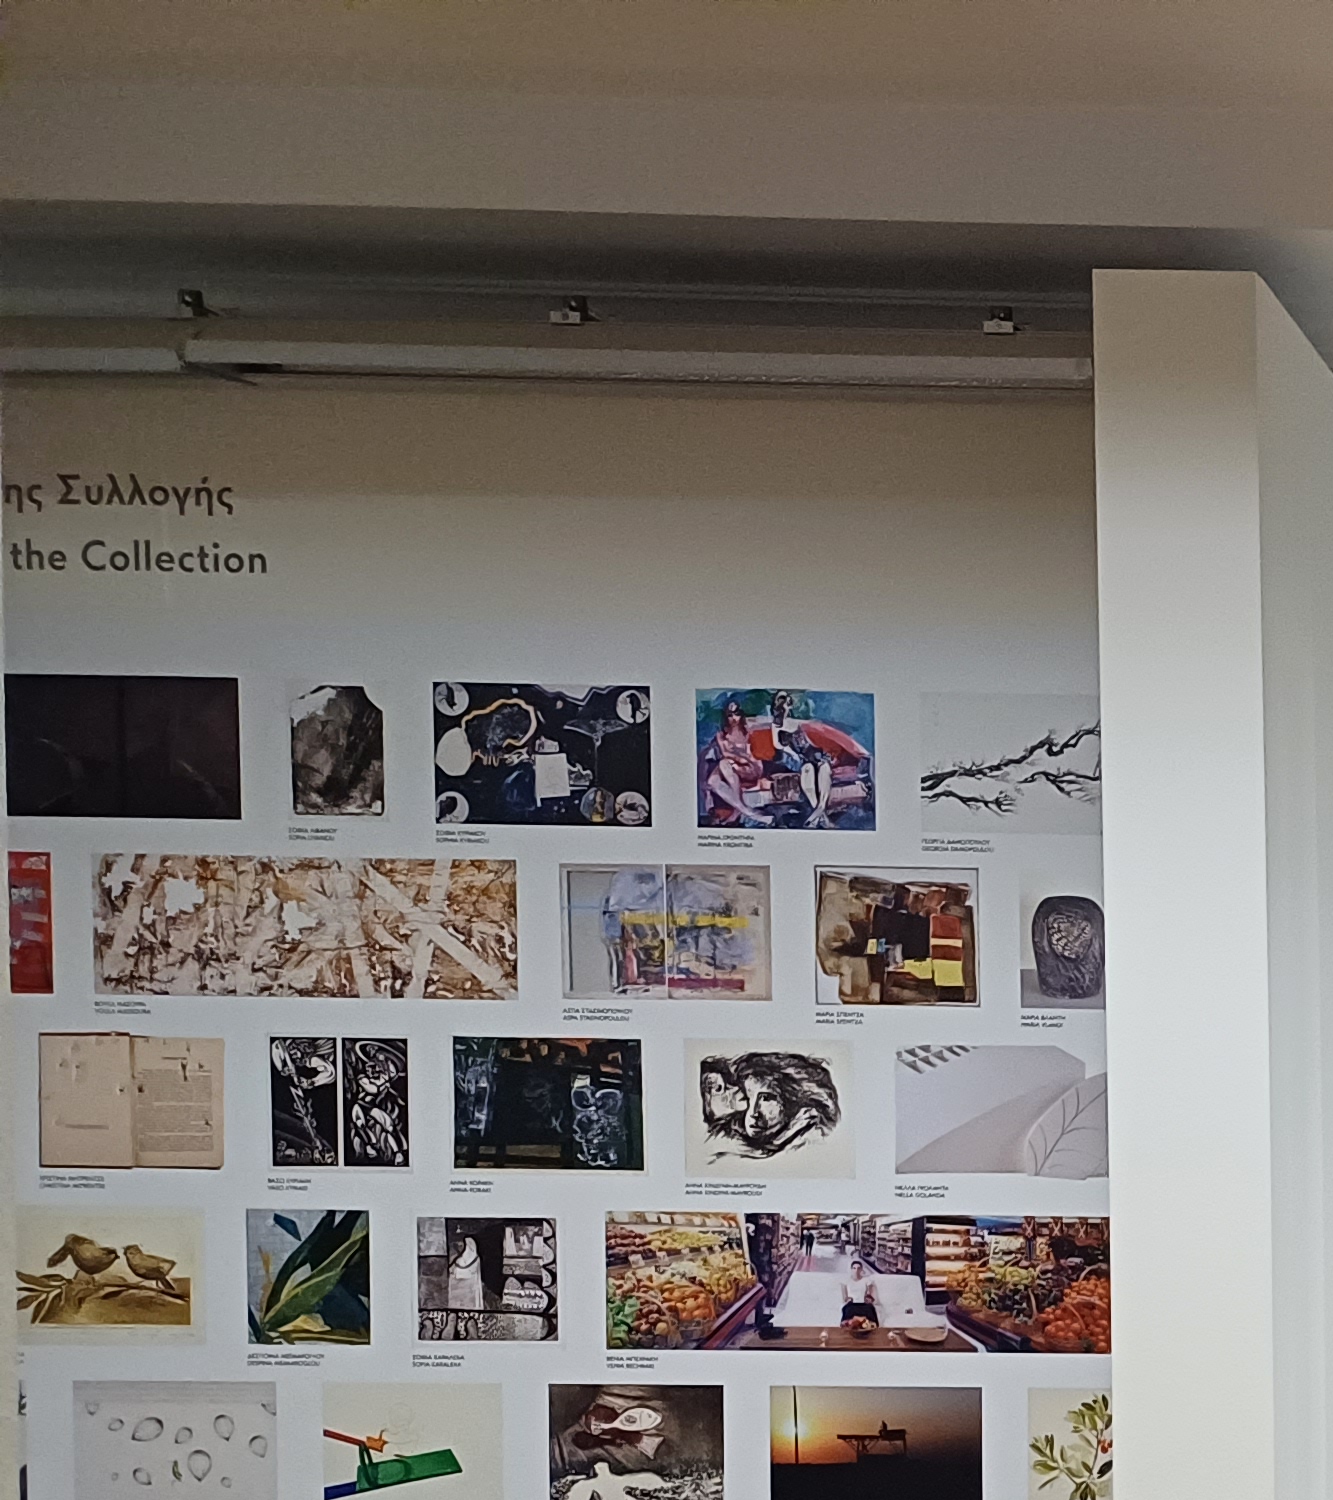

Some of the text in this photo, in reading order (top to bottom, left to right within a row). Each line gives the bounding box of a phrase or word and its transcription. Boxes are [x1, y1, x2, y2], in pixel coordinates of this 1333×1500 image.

[57, 473, 233, 516] Συλλογής
[10, 538, 267, 573] the Collection
